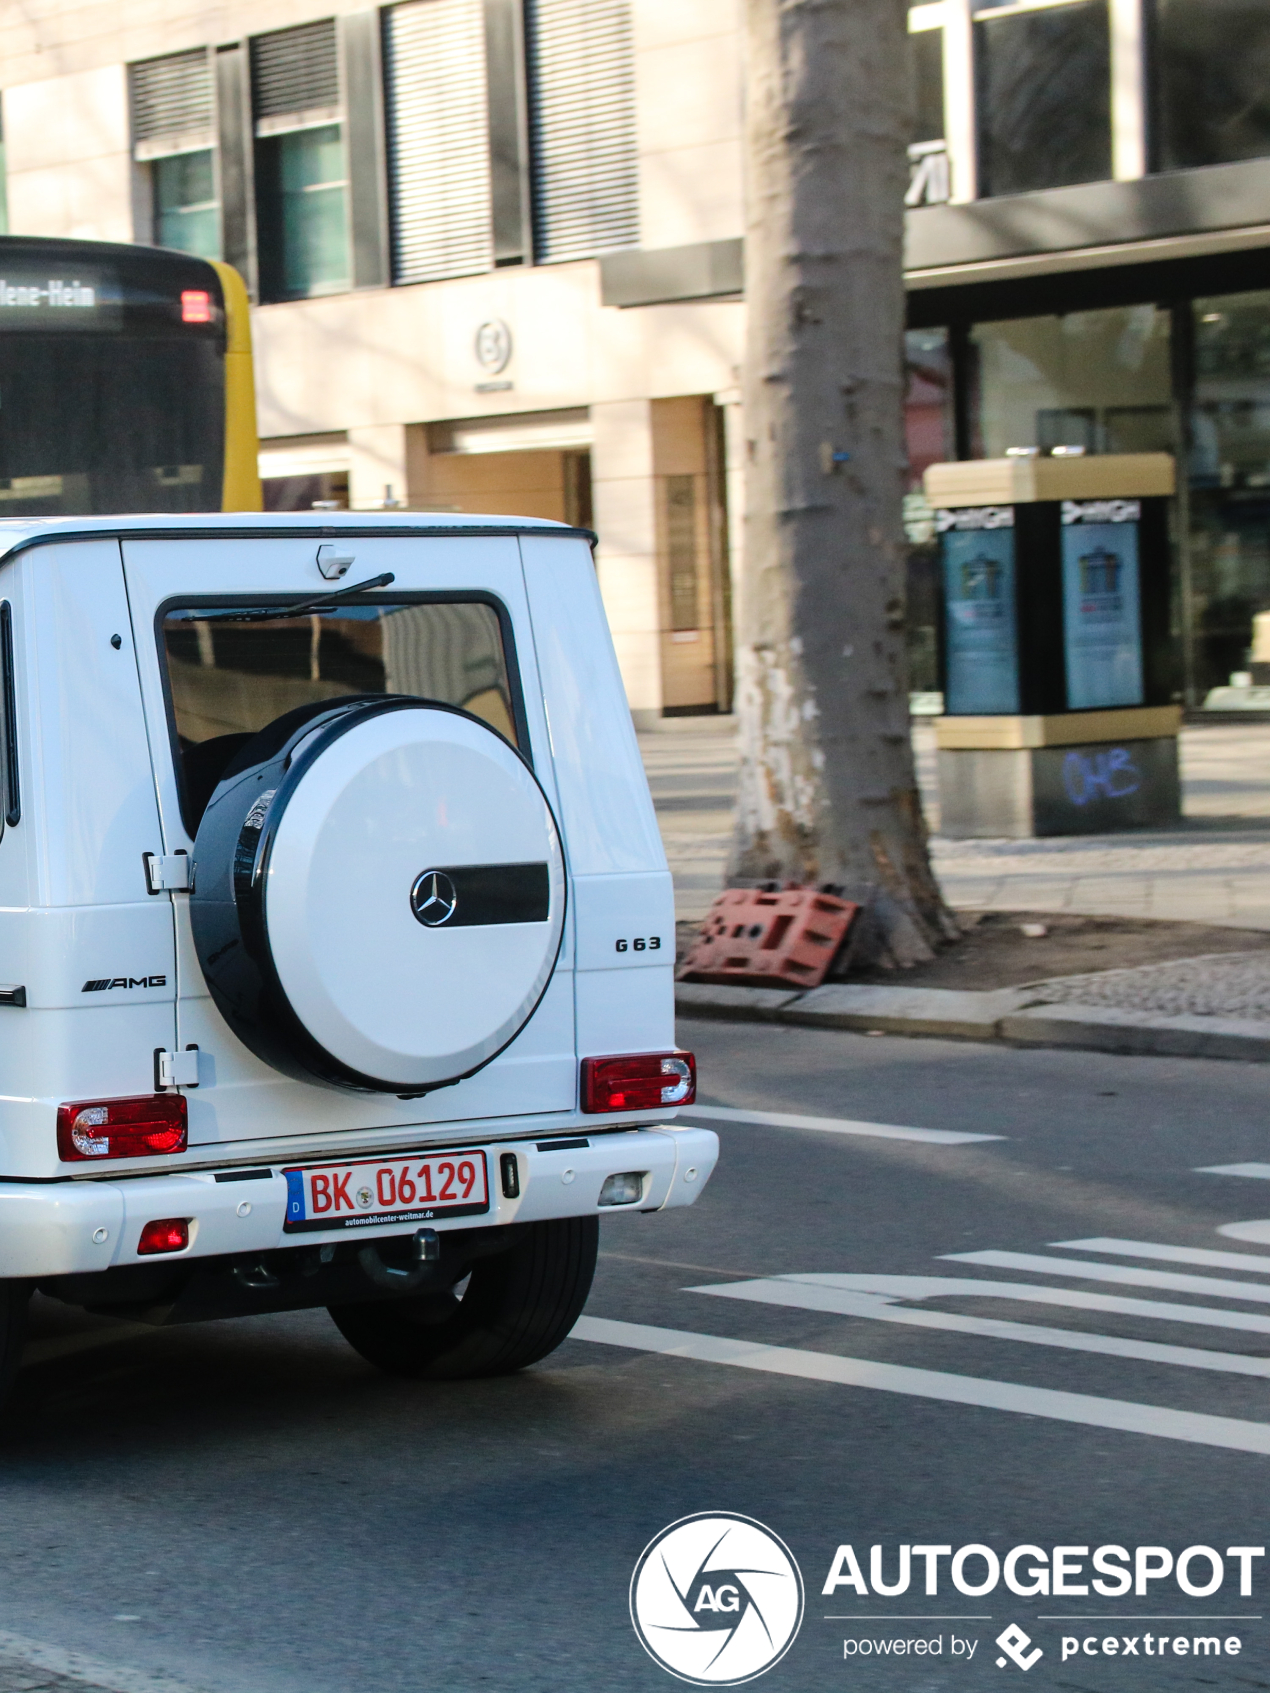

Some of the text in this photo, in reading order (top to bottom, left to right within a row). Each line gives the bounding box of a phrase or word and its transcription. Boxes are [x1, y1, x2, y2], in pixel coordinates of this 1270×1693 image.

[616, 936, 661, 952] G 63
[107, 975, 166, 990] AMG
[311, 1161, 476, 1213] BK 06129
[292, 1201, 300, 1213] D
[345, 1210, 434, 1226] automobilcenter-weitmar.de
